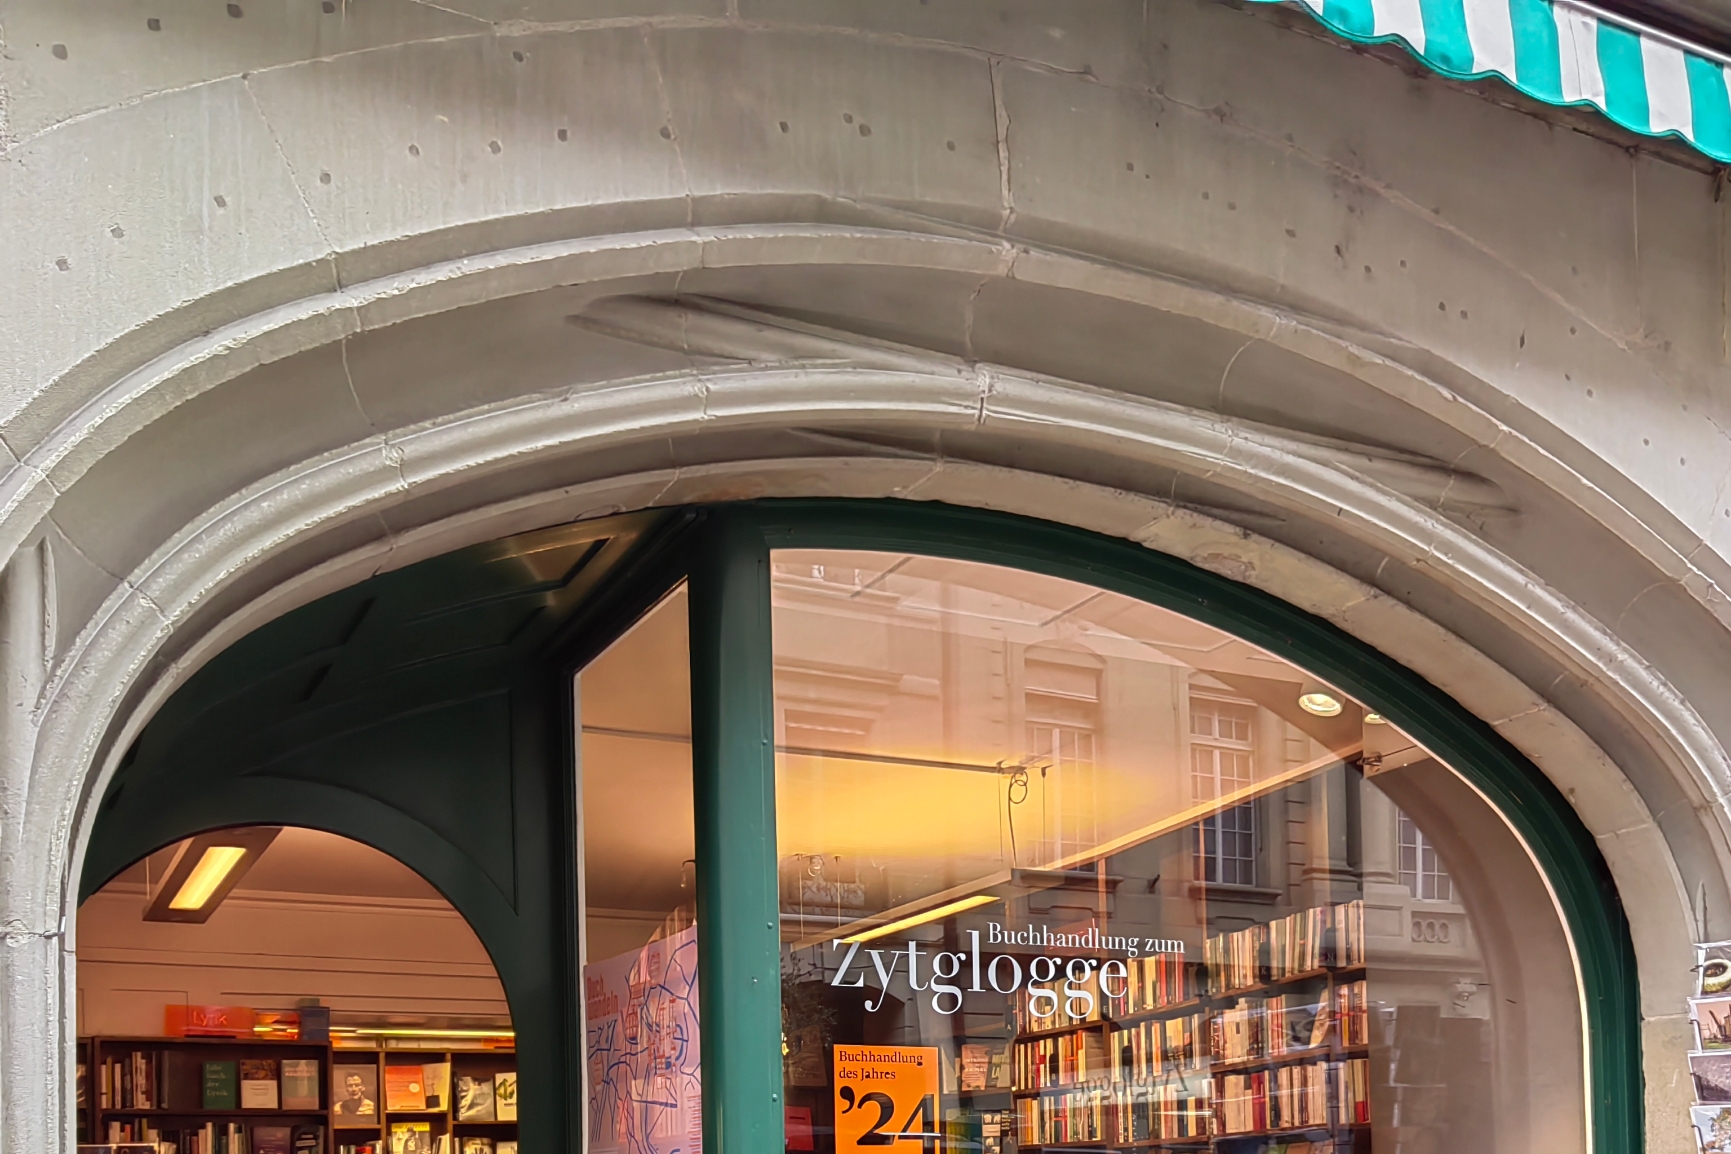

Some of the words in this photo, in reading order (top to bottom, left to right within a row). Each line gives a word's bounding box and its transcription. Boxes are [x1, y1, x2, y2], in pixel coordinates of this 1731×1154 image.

[987, 922, 1139, 958] Buchhandlung
[1145, 937, 1185, 954] zum
[830, 930, 1128, 1018] Zytglogge
[193, 1011, 228, 1026] Lyrik
[838, 1050, 924, 1067] Buchhandlung
[838, 1067, 857, 1080] des
[860, 1067, 897, 1081] Jahres
